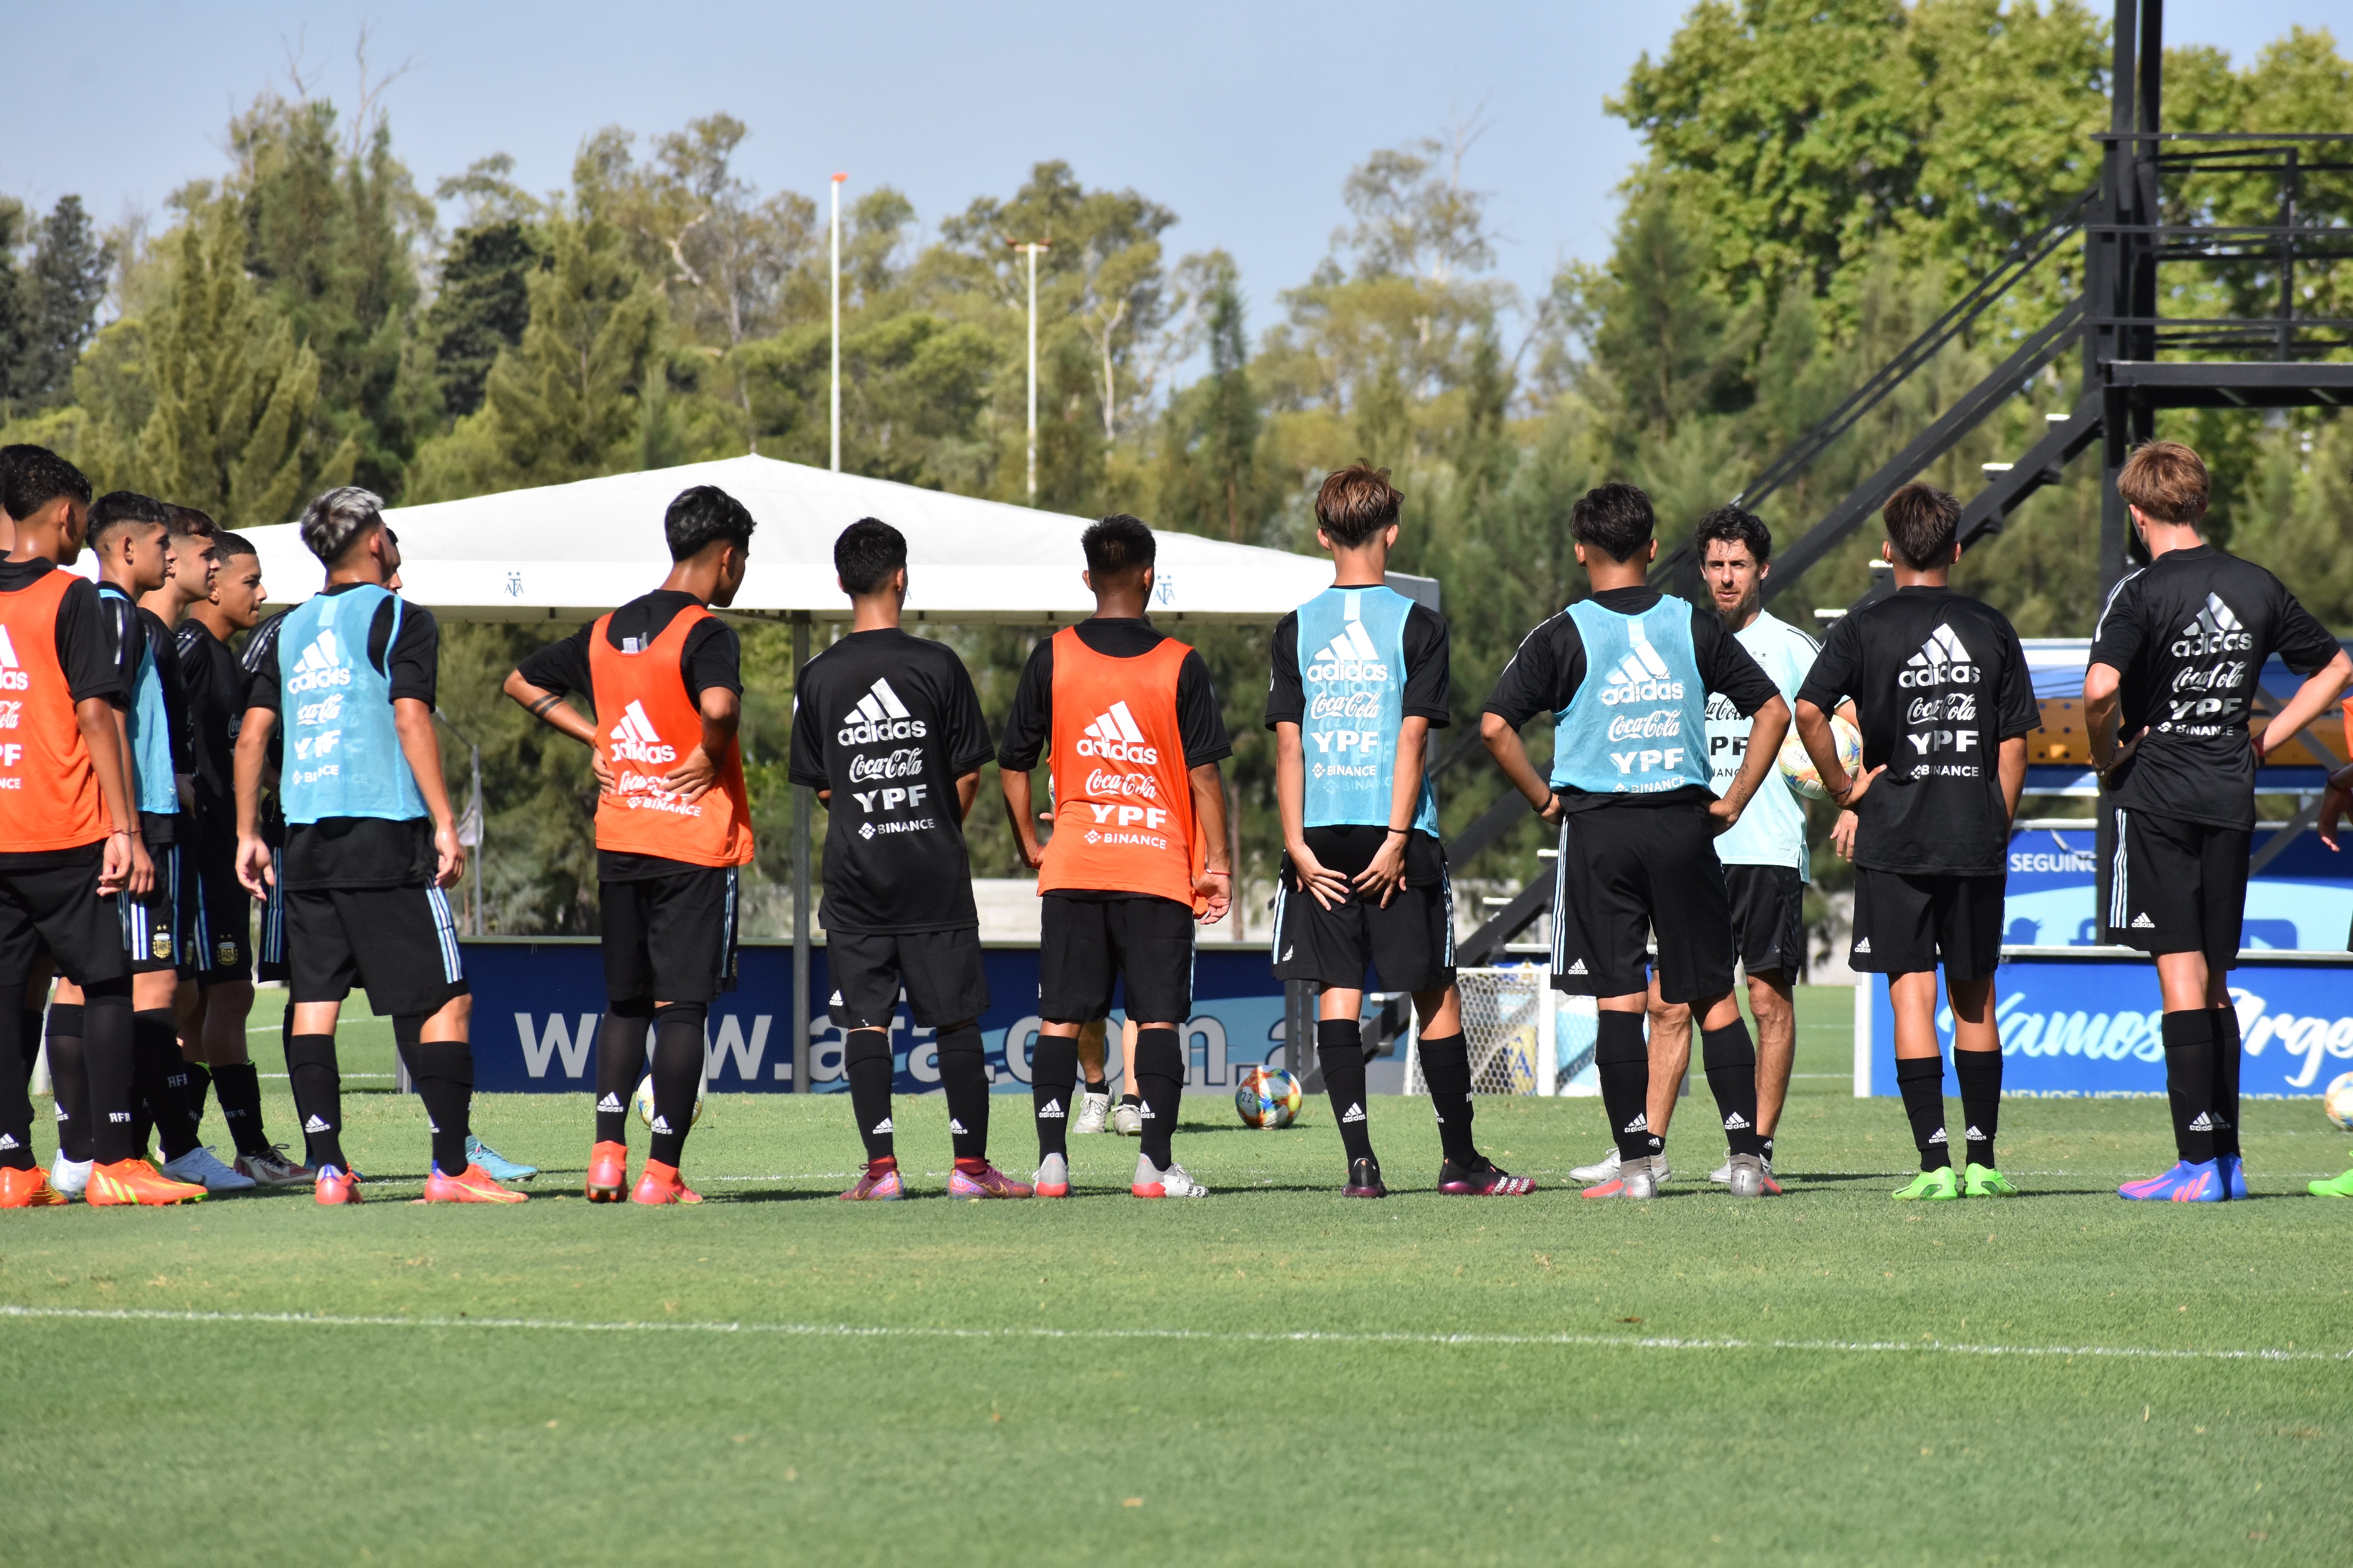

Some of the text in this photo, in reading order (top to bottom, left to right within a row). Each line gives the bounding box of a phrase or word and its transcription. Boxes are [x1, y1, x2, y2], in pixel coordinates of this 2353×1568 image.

[2171, 630, 2252, 658] adidas
[1306, 659, 1388, 682] adidas
[1898, 660, 1981, 688] adidas
[1601, 678, 1683, 706] adidas
[1310, 691, 1381, 720] Coca-Cola
[1906, 693, 1977, 725] Coca-Cola
[2169, 698, 2243, 720] YPF
[837, 717, 927, 746] adidas
[1608, 709, 1682, 743] Coca-Cola
[1076, 736, 1157, 765] adidas
[1310, 730, 1379, 753] YPF
[1710, 736, 1749, 756] PF
[1906, 730, 1979, 755] YPF
[849, 747, 924, 783] Coca-Cola
[1327, 764, 1377, 777] BINANCE
[1609, 747, 1685, 775] YPF
[1920, 764, 1979, 777] BINANCE
[1085, 768, 1156, 799] Coca-Cola
[642, 797, 702, 817] BINANCE
[852, 784, 927, 813] YPF
[877, 818, 935, 835] BINANCE
[1089, 804, 1167, 829] YPF
[1104, 832, 1167, 849] BINANCE
[1568, 966, 1588, 975] adidas
[1342, 1114, 1366, 1123] adidas
[1724, 1121, 1750, 1130] adidas
